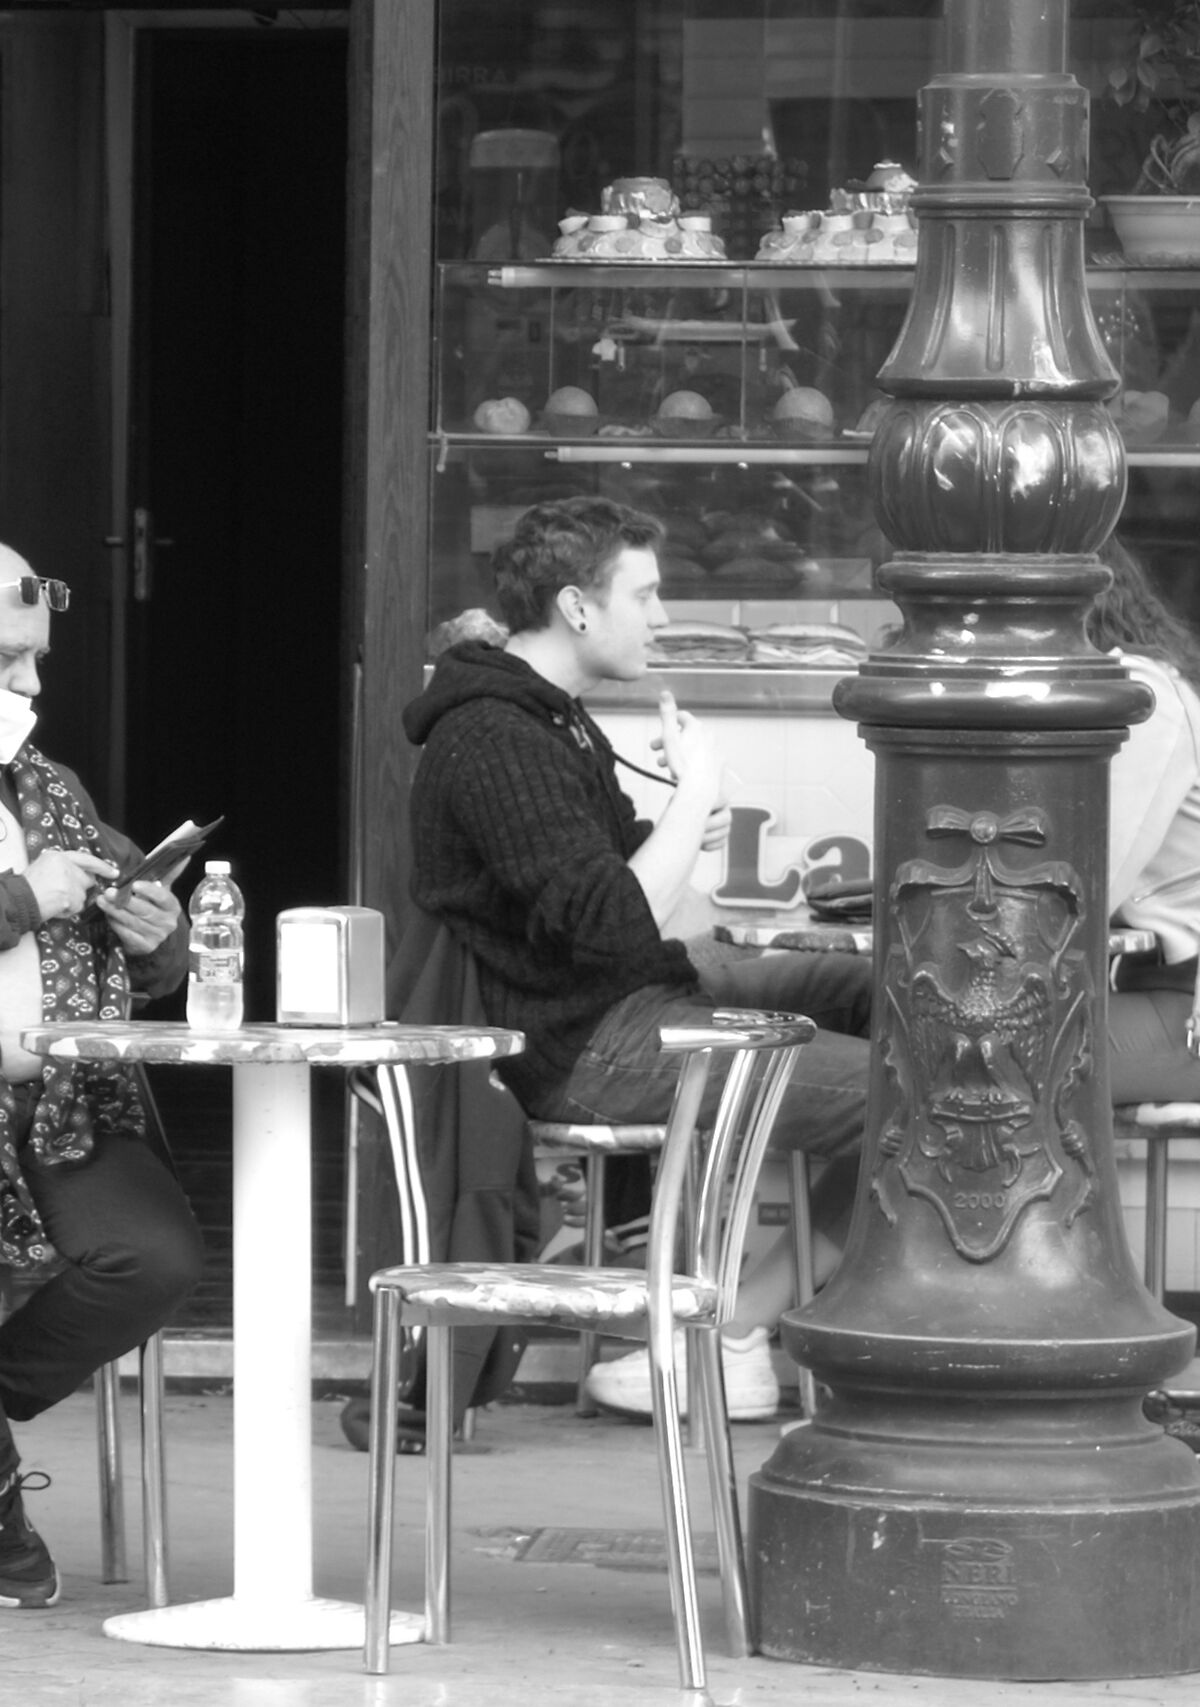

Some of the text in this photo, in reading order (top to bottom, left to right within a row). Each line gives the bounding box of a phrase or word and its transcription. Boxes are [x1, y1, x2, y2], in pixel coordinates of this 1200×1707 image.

[715, 807, 870, 902] La
[954, 1192, 1005, 1209] 2000
[941, 1560, 1017, 1584] NERI
